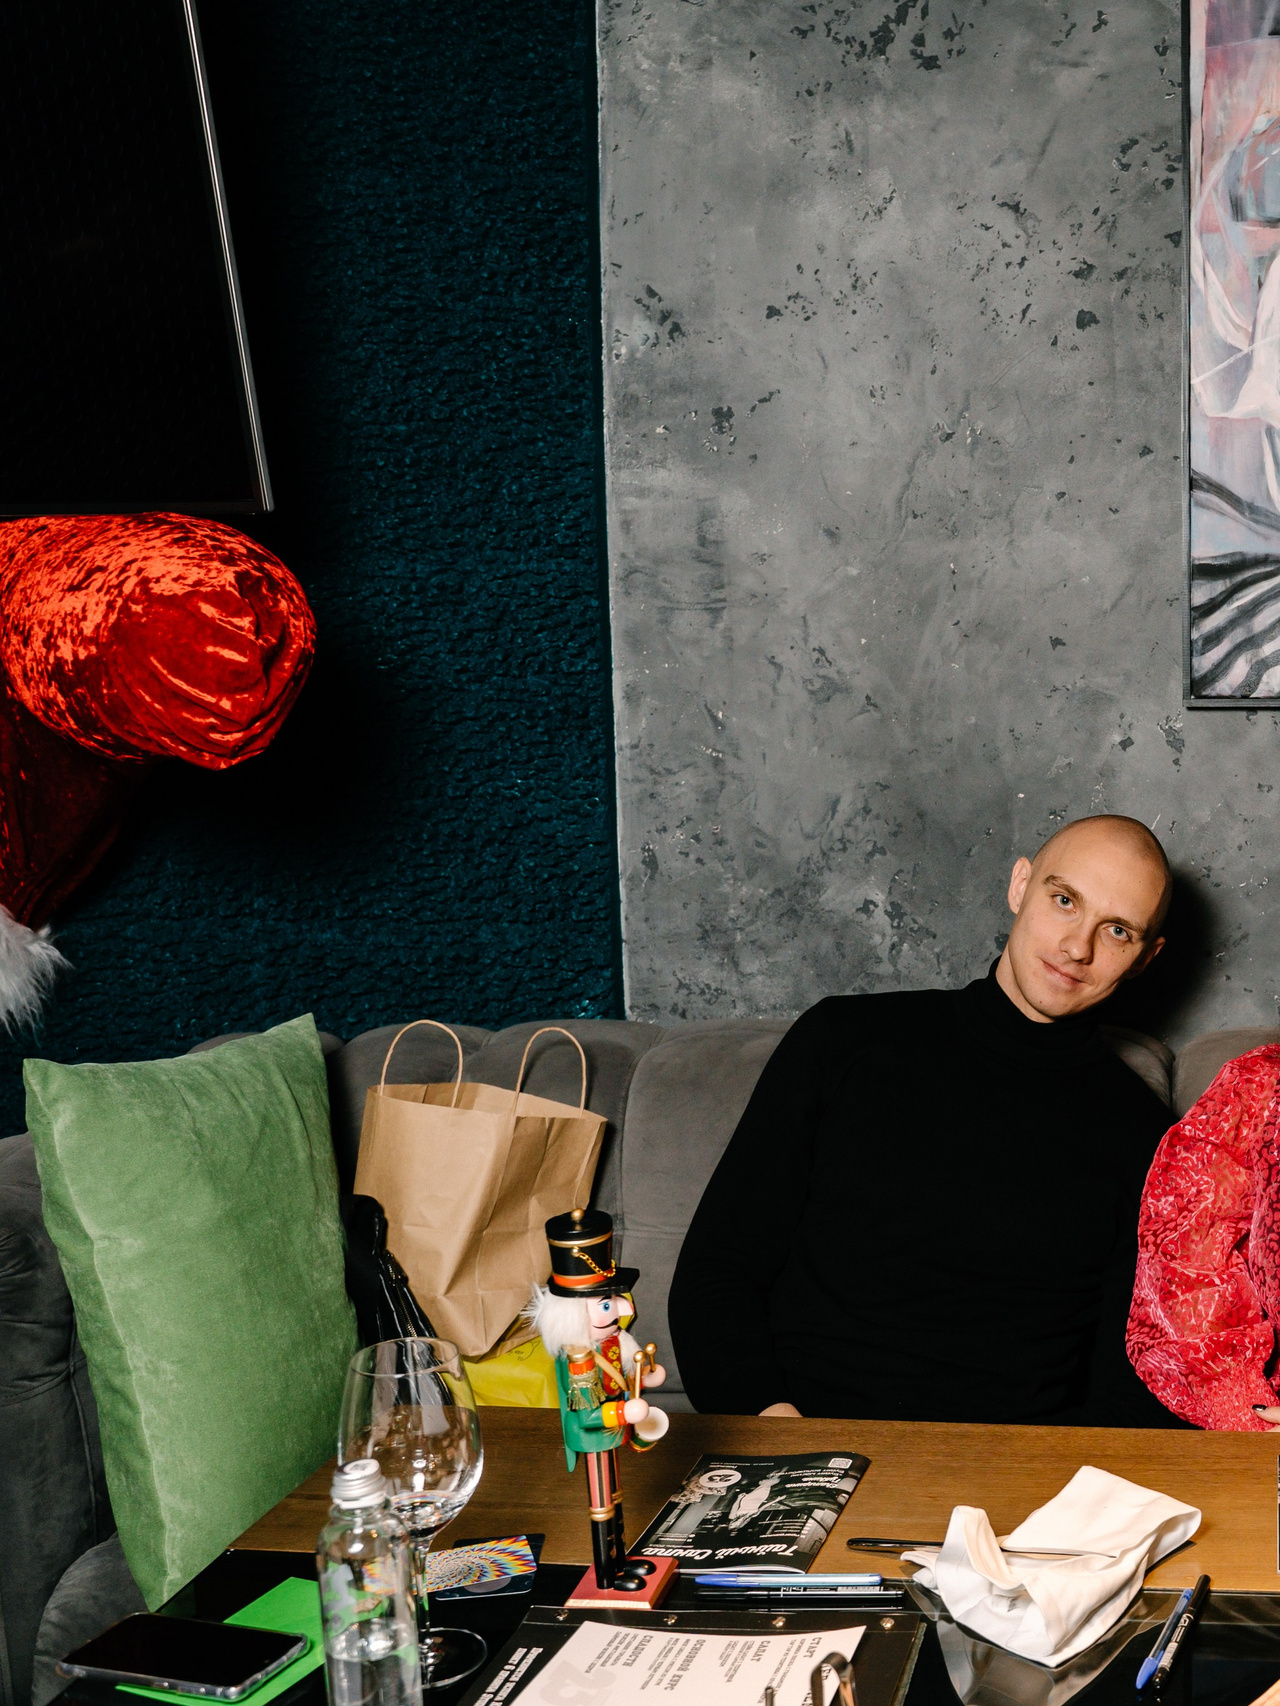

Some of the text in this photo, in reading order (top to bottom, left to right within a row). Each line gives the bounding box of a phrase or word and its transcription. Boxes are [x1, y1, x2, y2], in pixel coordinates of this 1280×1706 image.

[641, 1544, 799, 1560] Тайный Санта
[803, 1636, 822, 1659] СТАРТ
